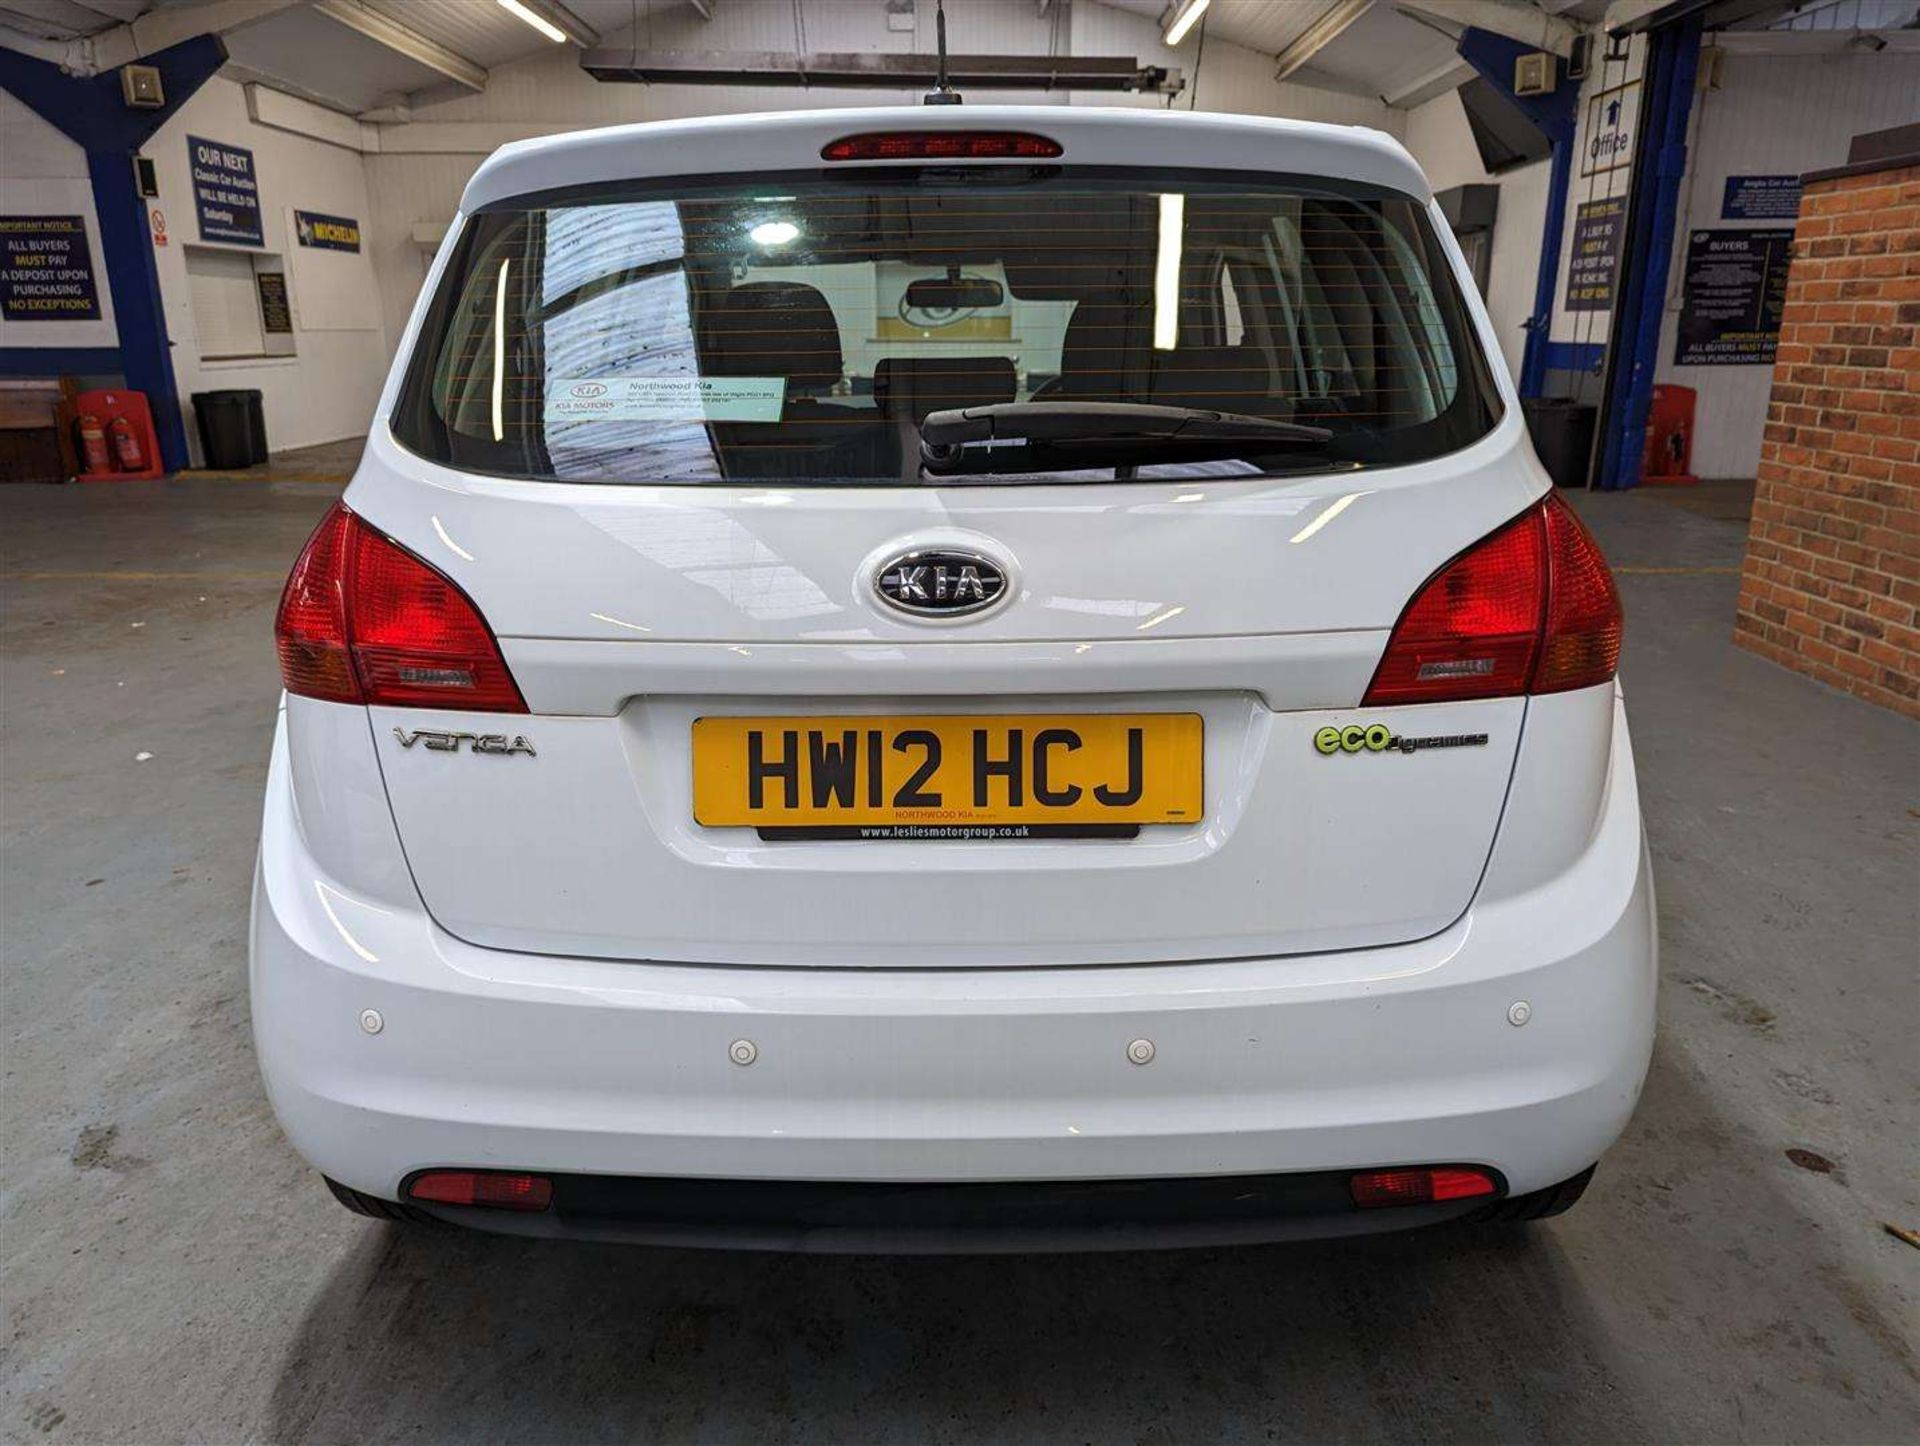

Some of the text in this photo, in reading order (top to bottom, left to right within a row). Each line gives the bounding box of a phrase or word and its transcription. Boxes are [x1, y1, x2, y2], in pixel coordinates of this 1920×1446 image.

[1591, 132, 1628, 159] Office
[198, 146, 248, 172] OUR NEXT
[195, 167, 219, 183] Classic
[220, 173, 231, 186] Car
[199, 188, 256, 207] WILL BE HELD ON
[204, 207, 233, 225] Saturday
[0, 222, 43, 231] MPORTANT
[314, 222, 360, 245] MICHELIN
[8, 240, 71, 251] ALL BUYERS
[1709, 241, 1749, 251] BUYERS
[15, 255, 67, 266] MUST PAY
[2, 270, 88, 280] A DEPOSIT UPON
[13, 284, 82, 295] PURCHASING
[8, 298, 91, 310] NO EXCEPTIONS
[1688, 344, 1703, 352] ALL
[1705, 344, 1736, 352] BUYERS
[1682, 354, 1705, 363] UPON
[630, 382, 713, 391] Northwood Kia
[574, 402, 615, 410] MOTORS
[898, 565, 985, 599] KIA
[748, 728, 1144, 809] HW12 HCJ
[895, 810, 956, 820] NORTHWOOD
[958, 810, 974, 819] KIA
[861, 825, 1029, 840] www.lesliesmotorgroup.co.uk
